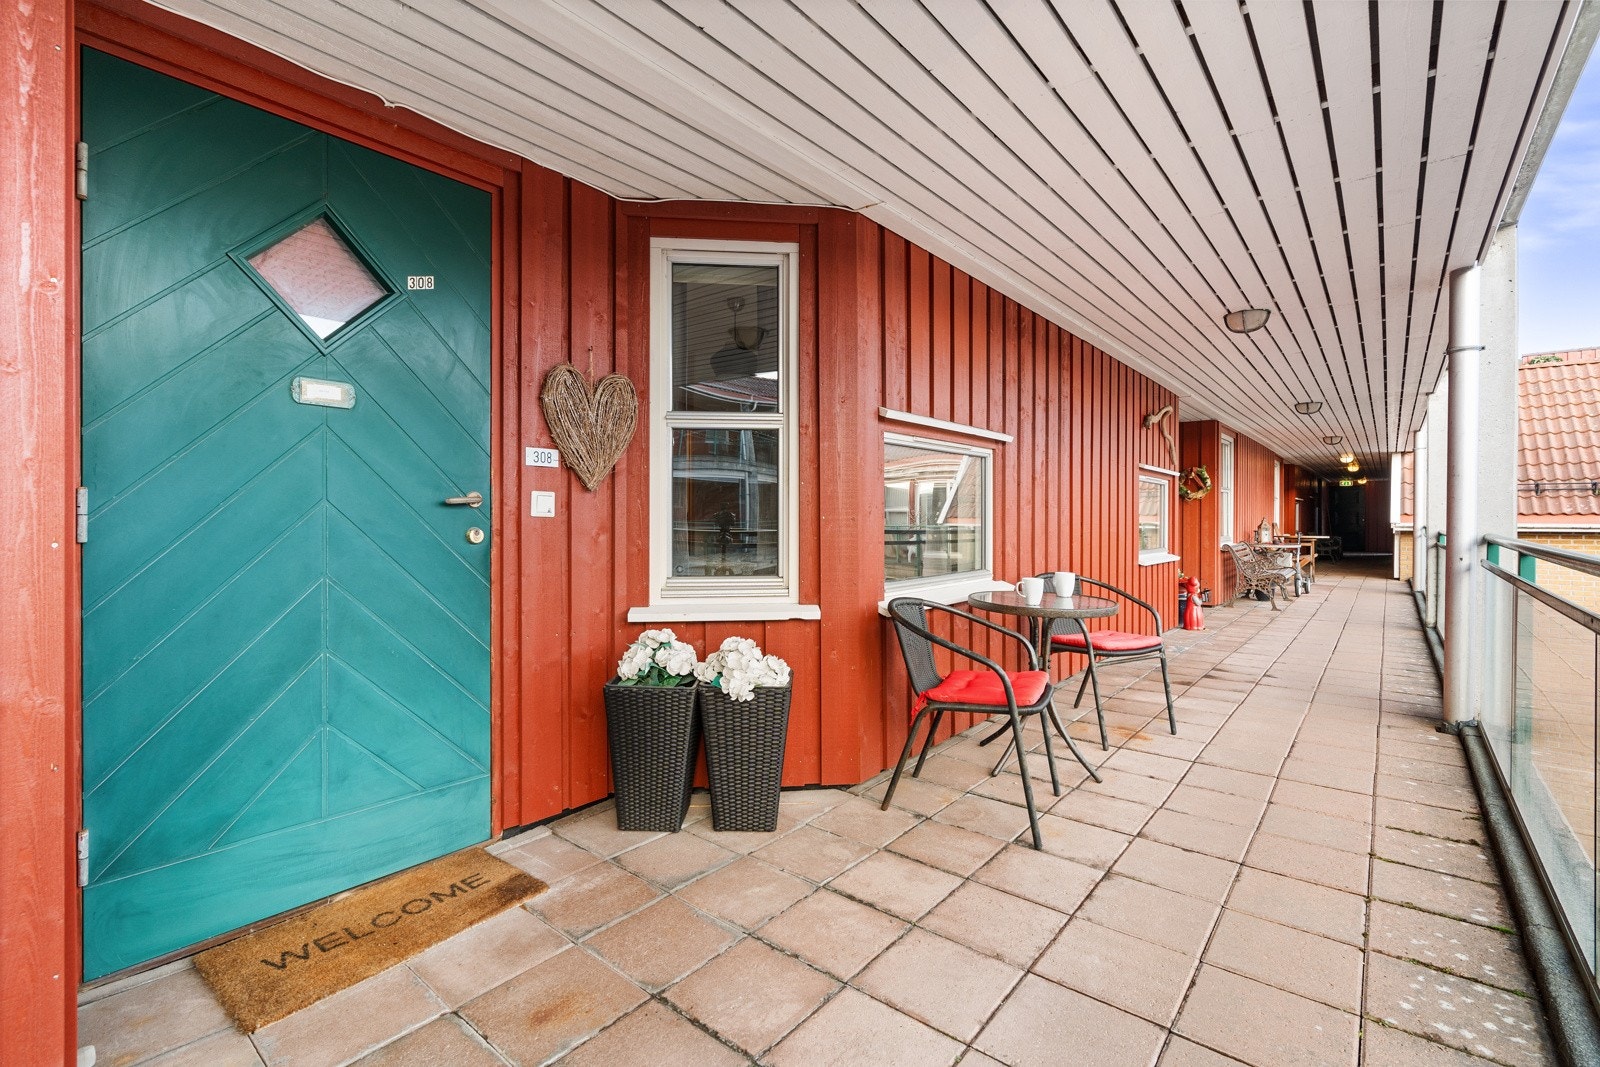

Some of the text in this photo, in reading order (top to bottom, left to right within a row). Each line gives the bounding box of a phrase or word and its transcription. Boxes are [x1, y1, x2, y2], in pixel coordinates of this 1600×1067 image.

[409, 277, 433, 289] 308
[533, 450, 552, 464] 308
[261, 872, 490, 972] WELCOME
